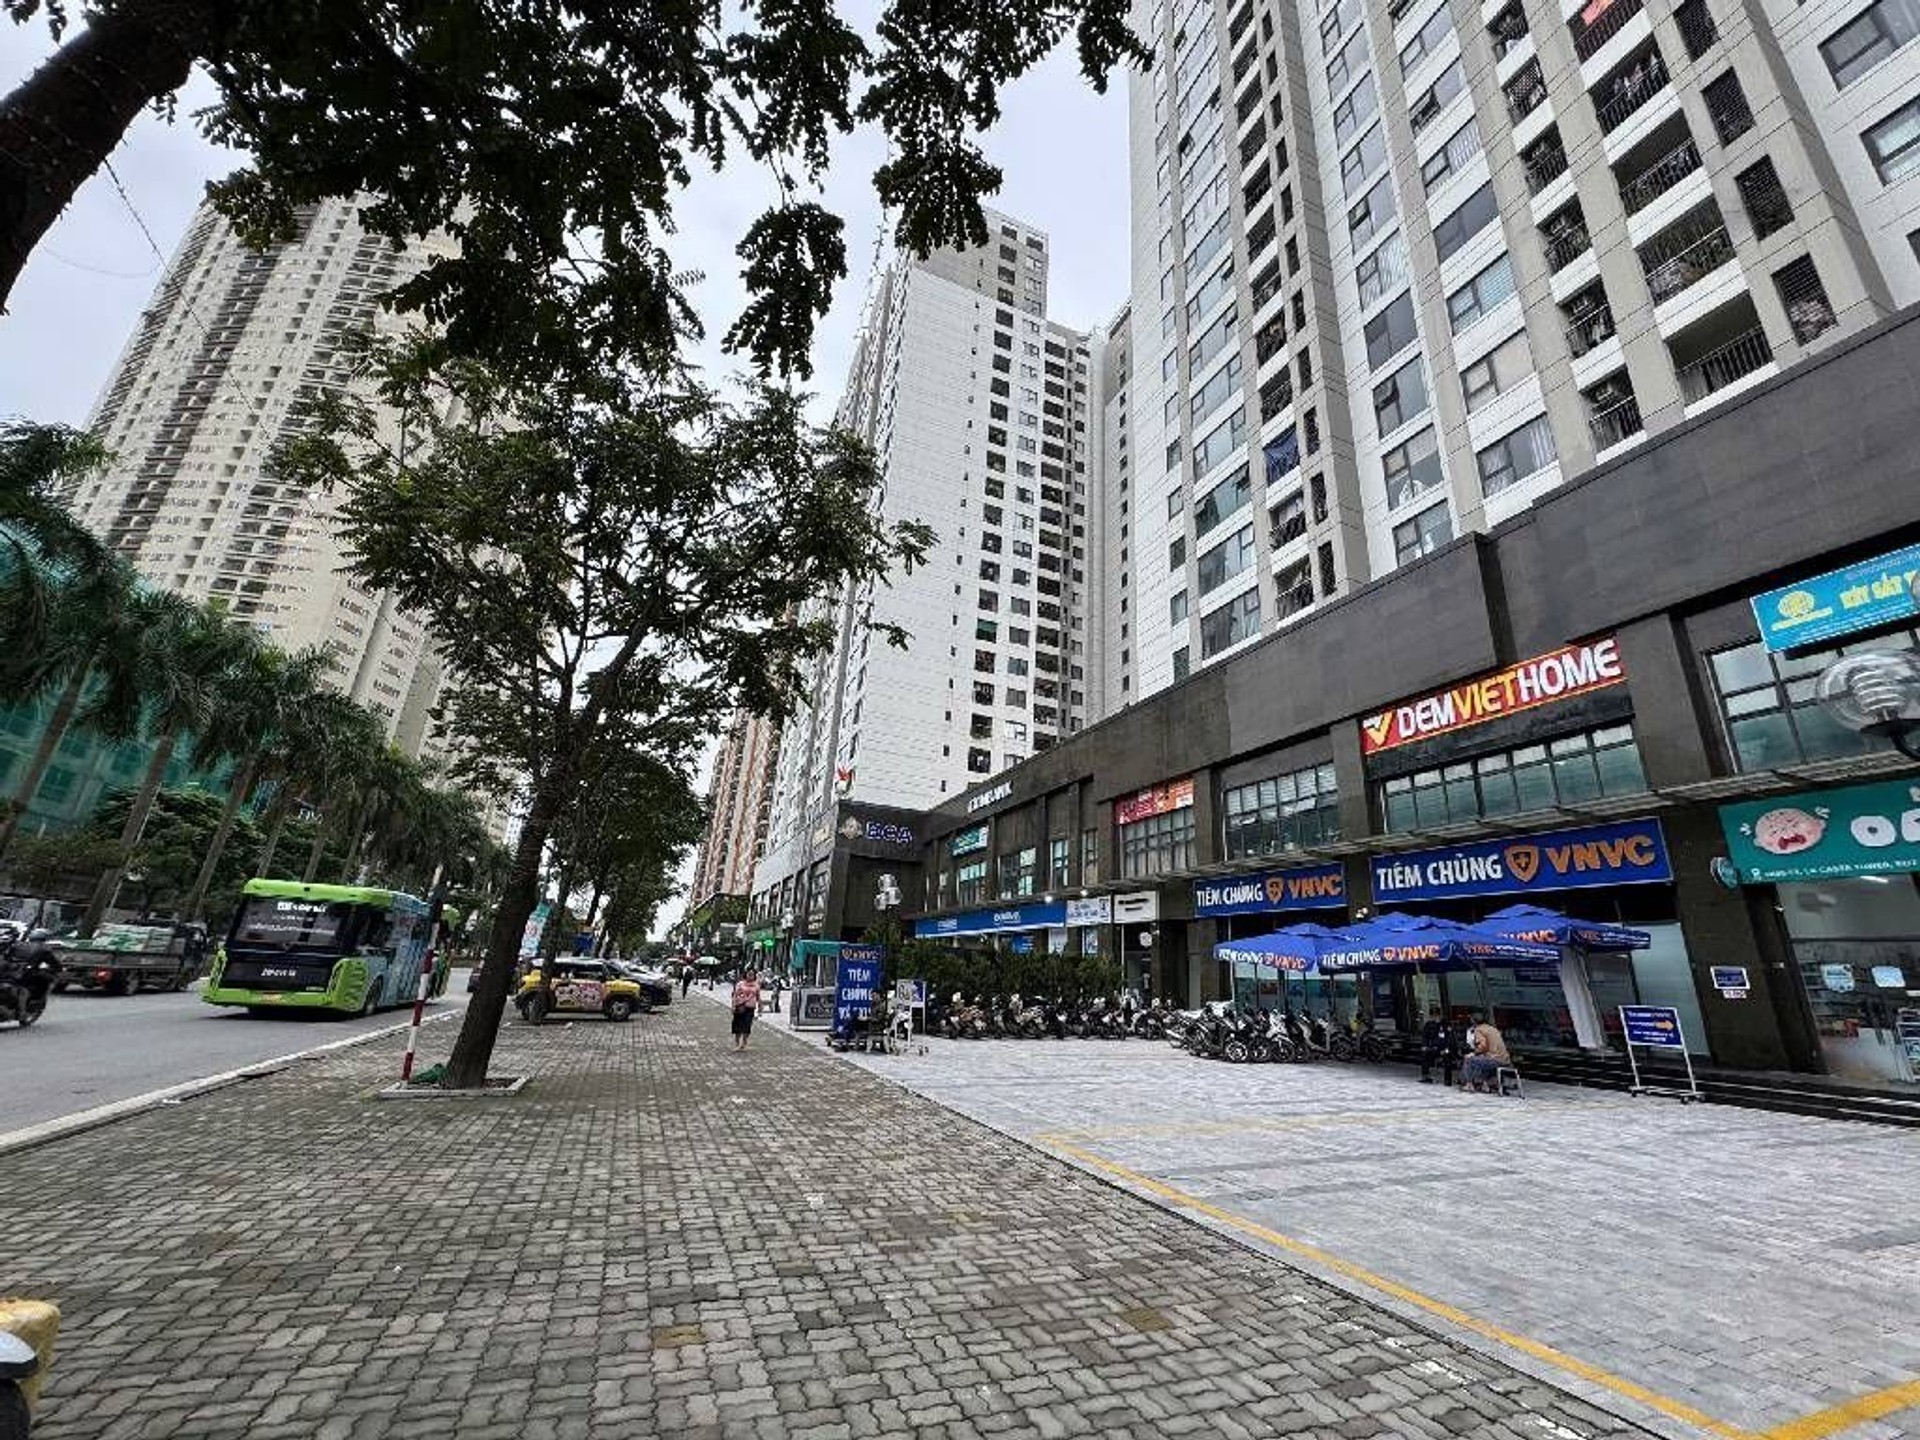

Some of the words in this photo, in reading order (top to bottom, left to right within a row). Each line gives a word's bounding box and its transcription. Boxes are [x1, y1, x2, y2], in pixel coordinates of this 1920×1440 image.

[1397, 639, 1621, 737] DEMVIETHOME
[1376, 861, 1422, 890] TIÊM
[1427, 852, 1503, 885] CHỦNG
[1545, 835, 1656, 873] VNVC
[1288, 874, 1342, 900] VNVC
[1398, 944, 1440, 961] VNVC
